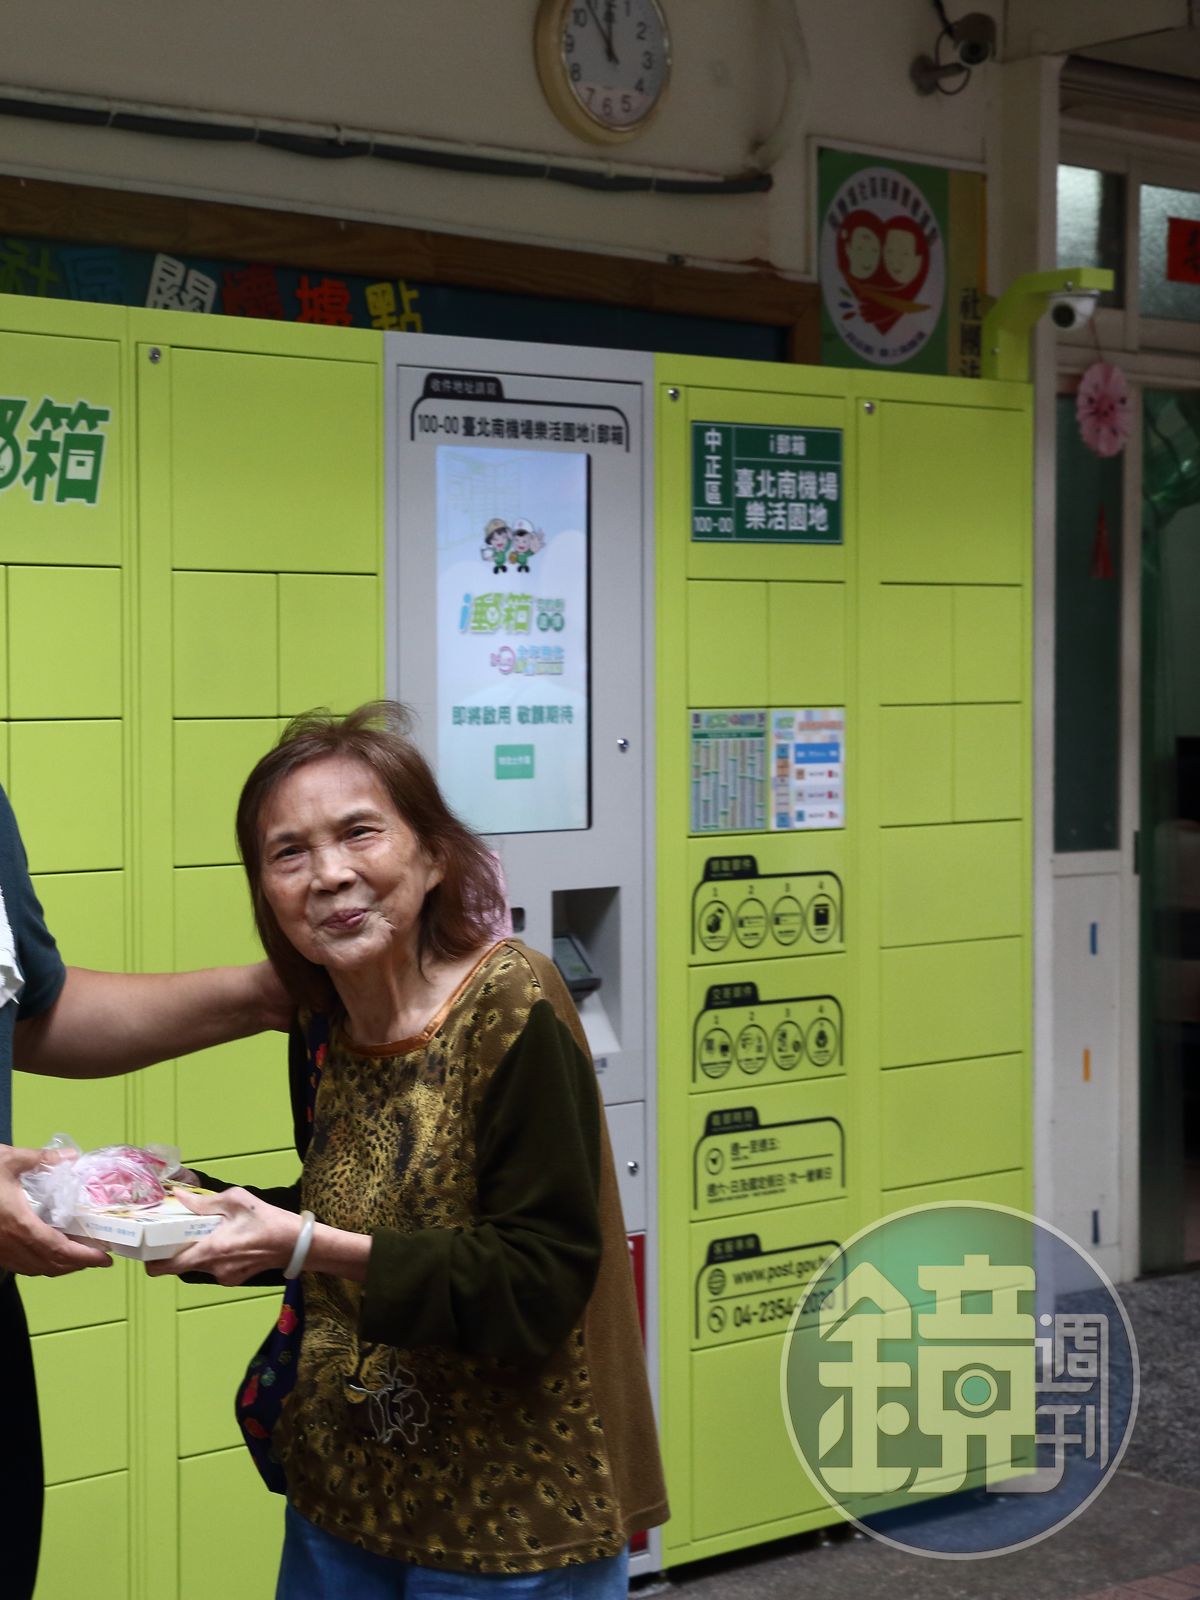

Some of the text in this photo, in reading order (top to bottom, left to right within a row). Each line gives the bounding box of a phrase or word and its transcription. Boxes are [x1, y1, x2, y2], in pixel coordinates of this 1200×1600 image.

[573, 8, 587, 27] 10
[636, 22, 647, 40] 2
[642, 51, 653, 70] 3
[570, 63, 581, 81] 8
[634, 78, 644, 94] 4
[585, 88, 595, 105] 7
[620, 94, 631, 113] 5
[602, 98, 612, 116] 6
[418, 414, 459, 433] 100-00
[768, 433, 807, 456] i郵箱
[703, 427, 723, 505] 中正區
[735, 467, 839, 502] 臺北南機場
[693, 516, 733, 533] 100-00
[745, 501, 829, 532] 樂活園地
